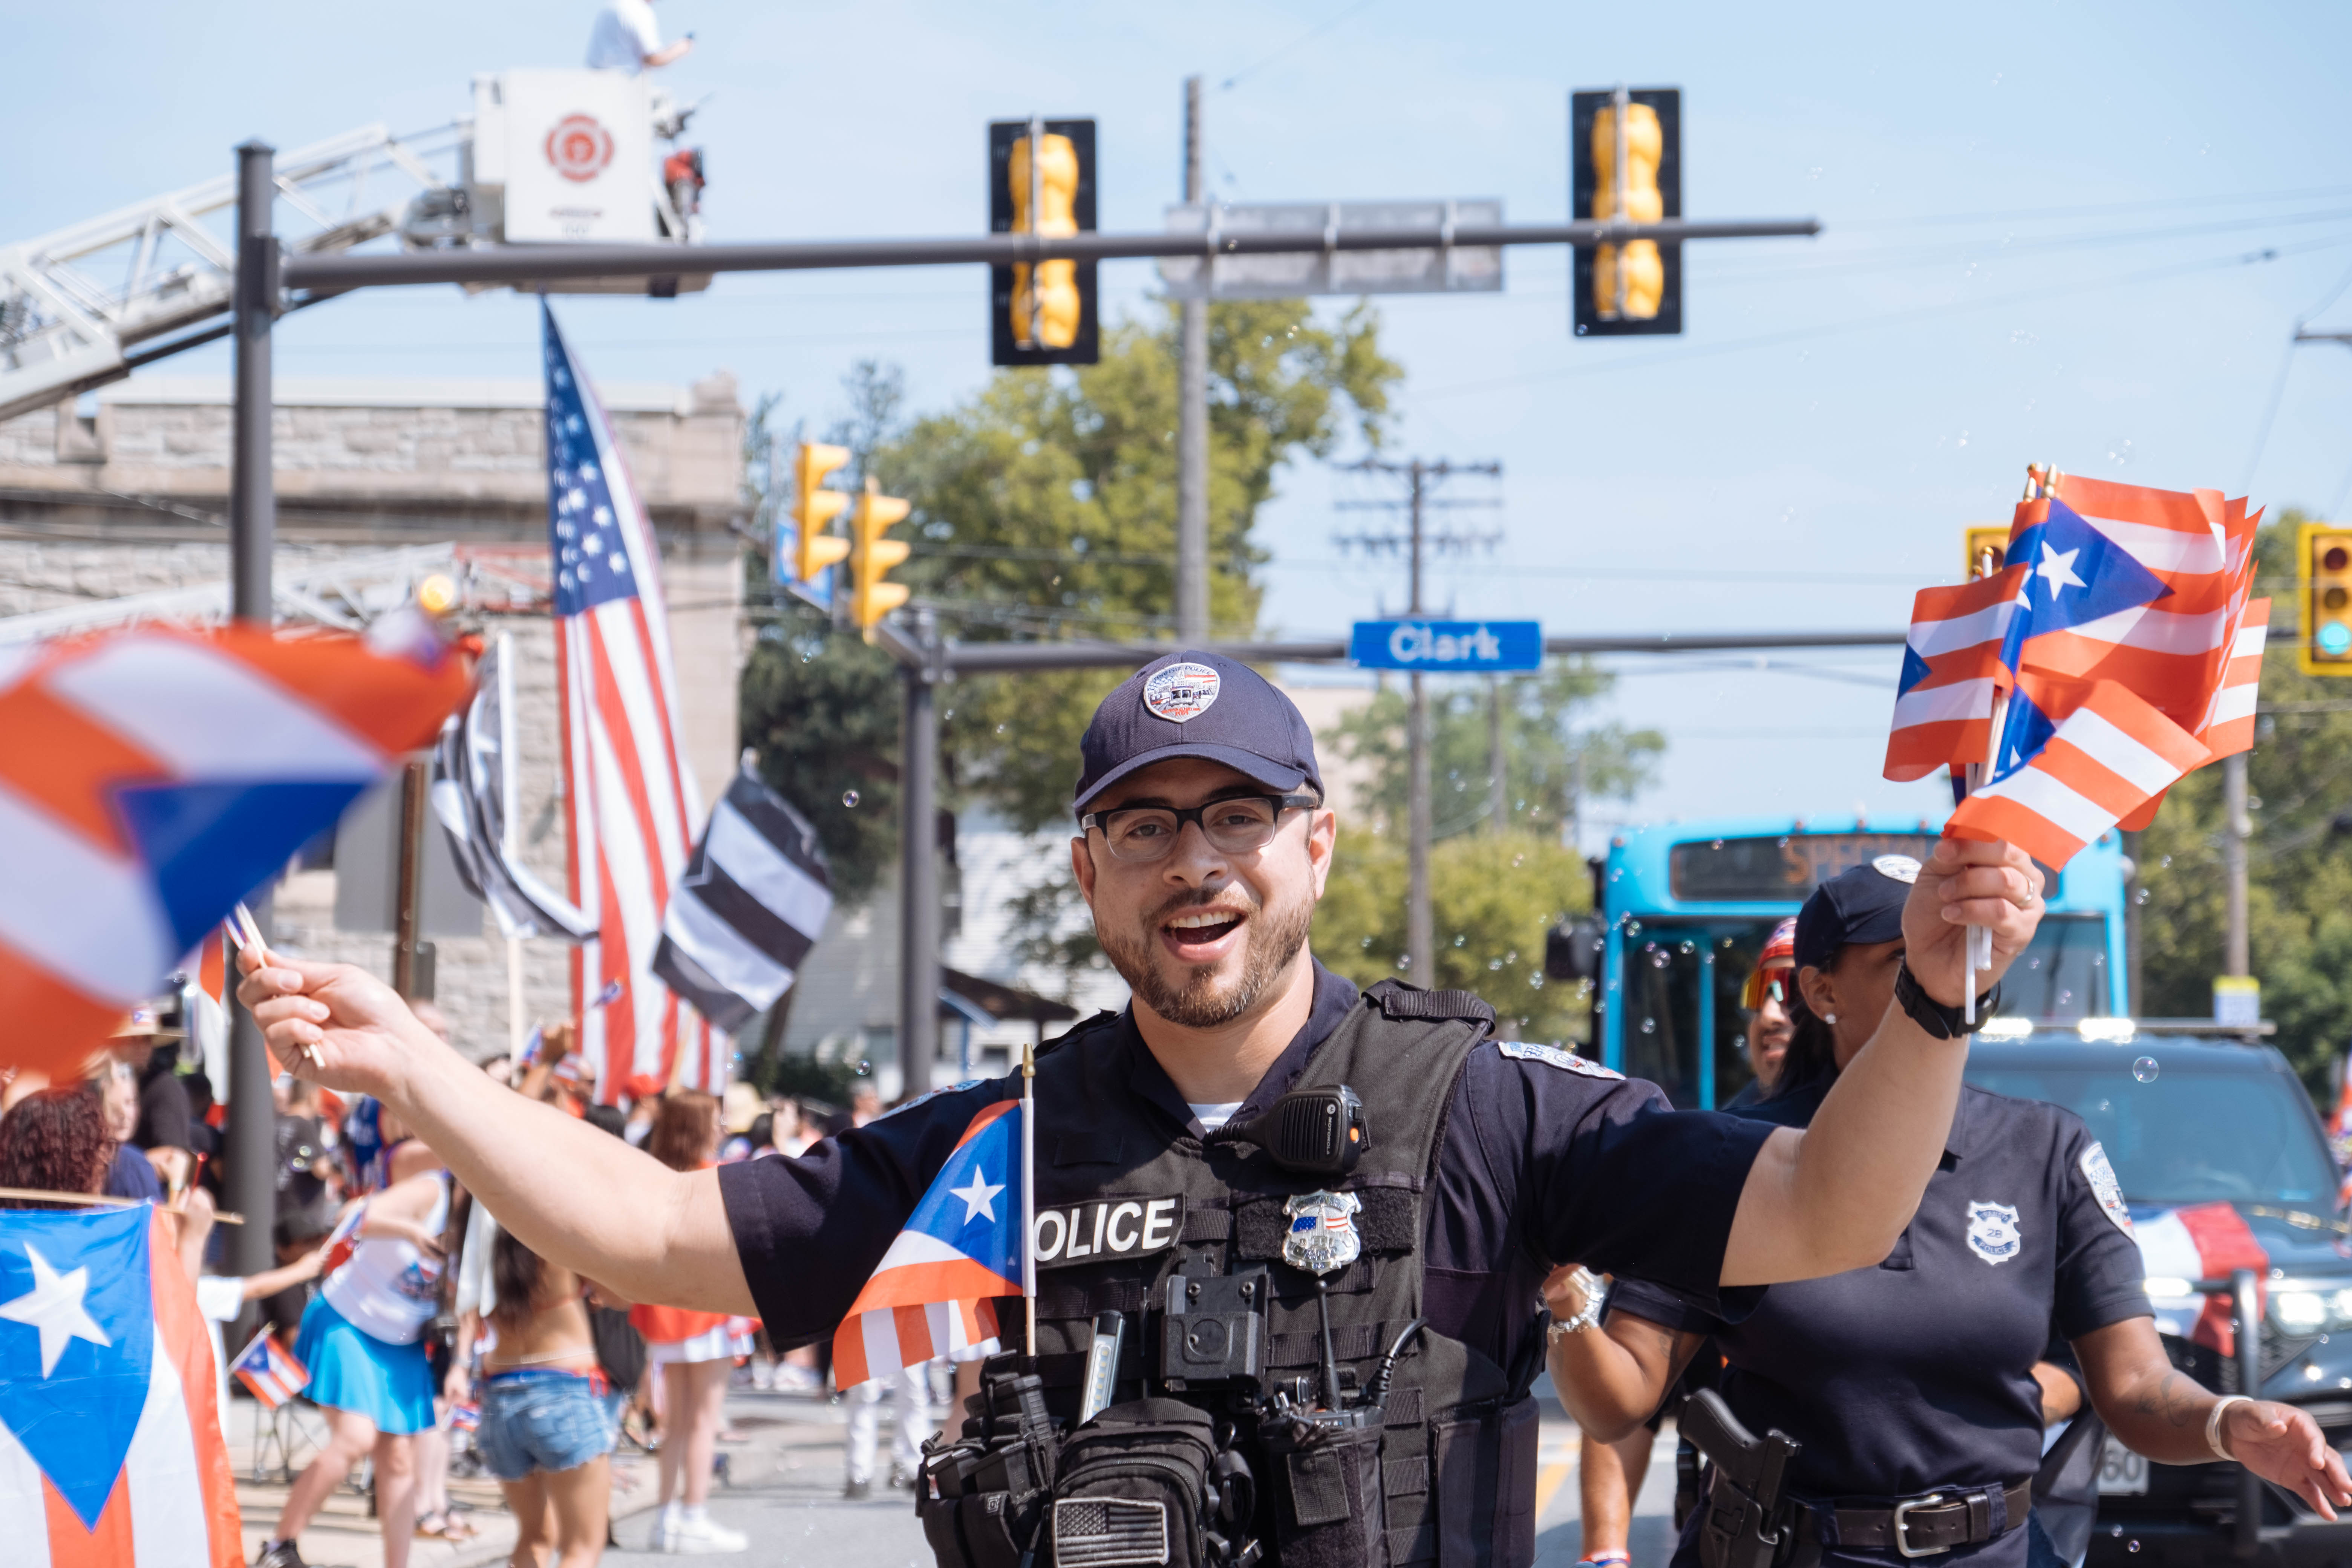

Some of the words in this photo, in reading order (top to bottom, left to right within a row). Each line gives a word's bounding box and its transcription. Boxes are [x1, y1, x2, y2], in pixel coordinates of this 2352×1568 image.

[1389, 625, 1499, 662] Clark
[1185, 666, 1212, 675] POLICE
[1782, 834, 1926, 884] SPECIA
[1034, 1199, 1176, 1262] OLICE
[1979, 1242, 2009, 1254] POLICE
